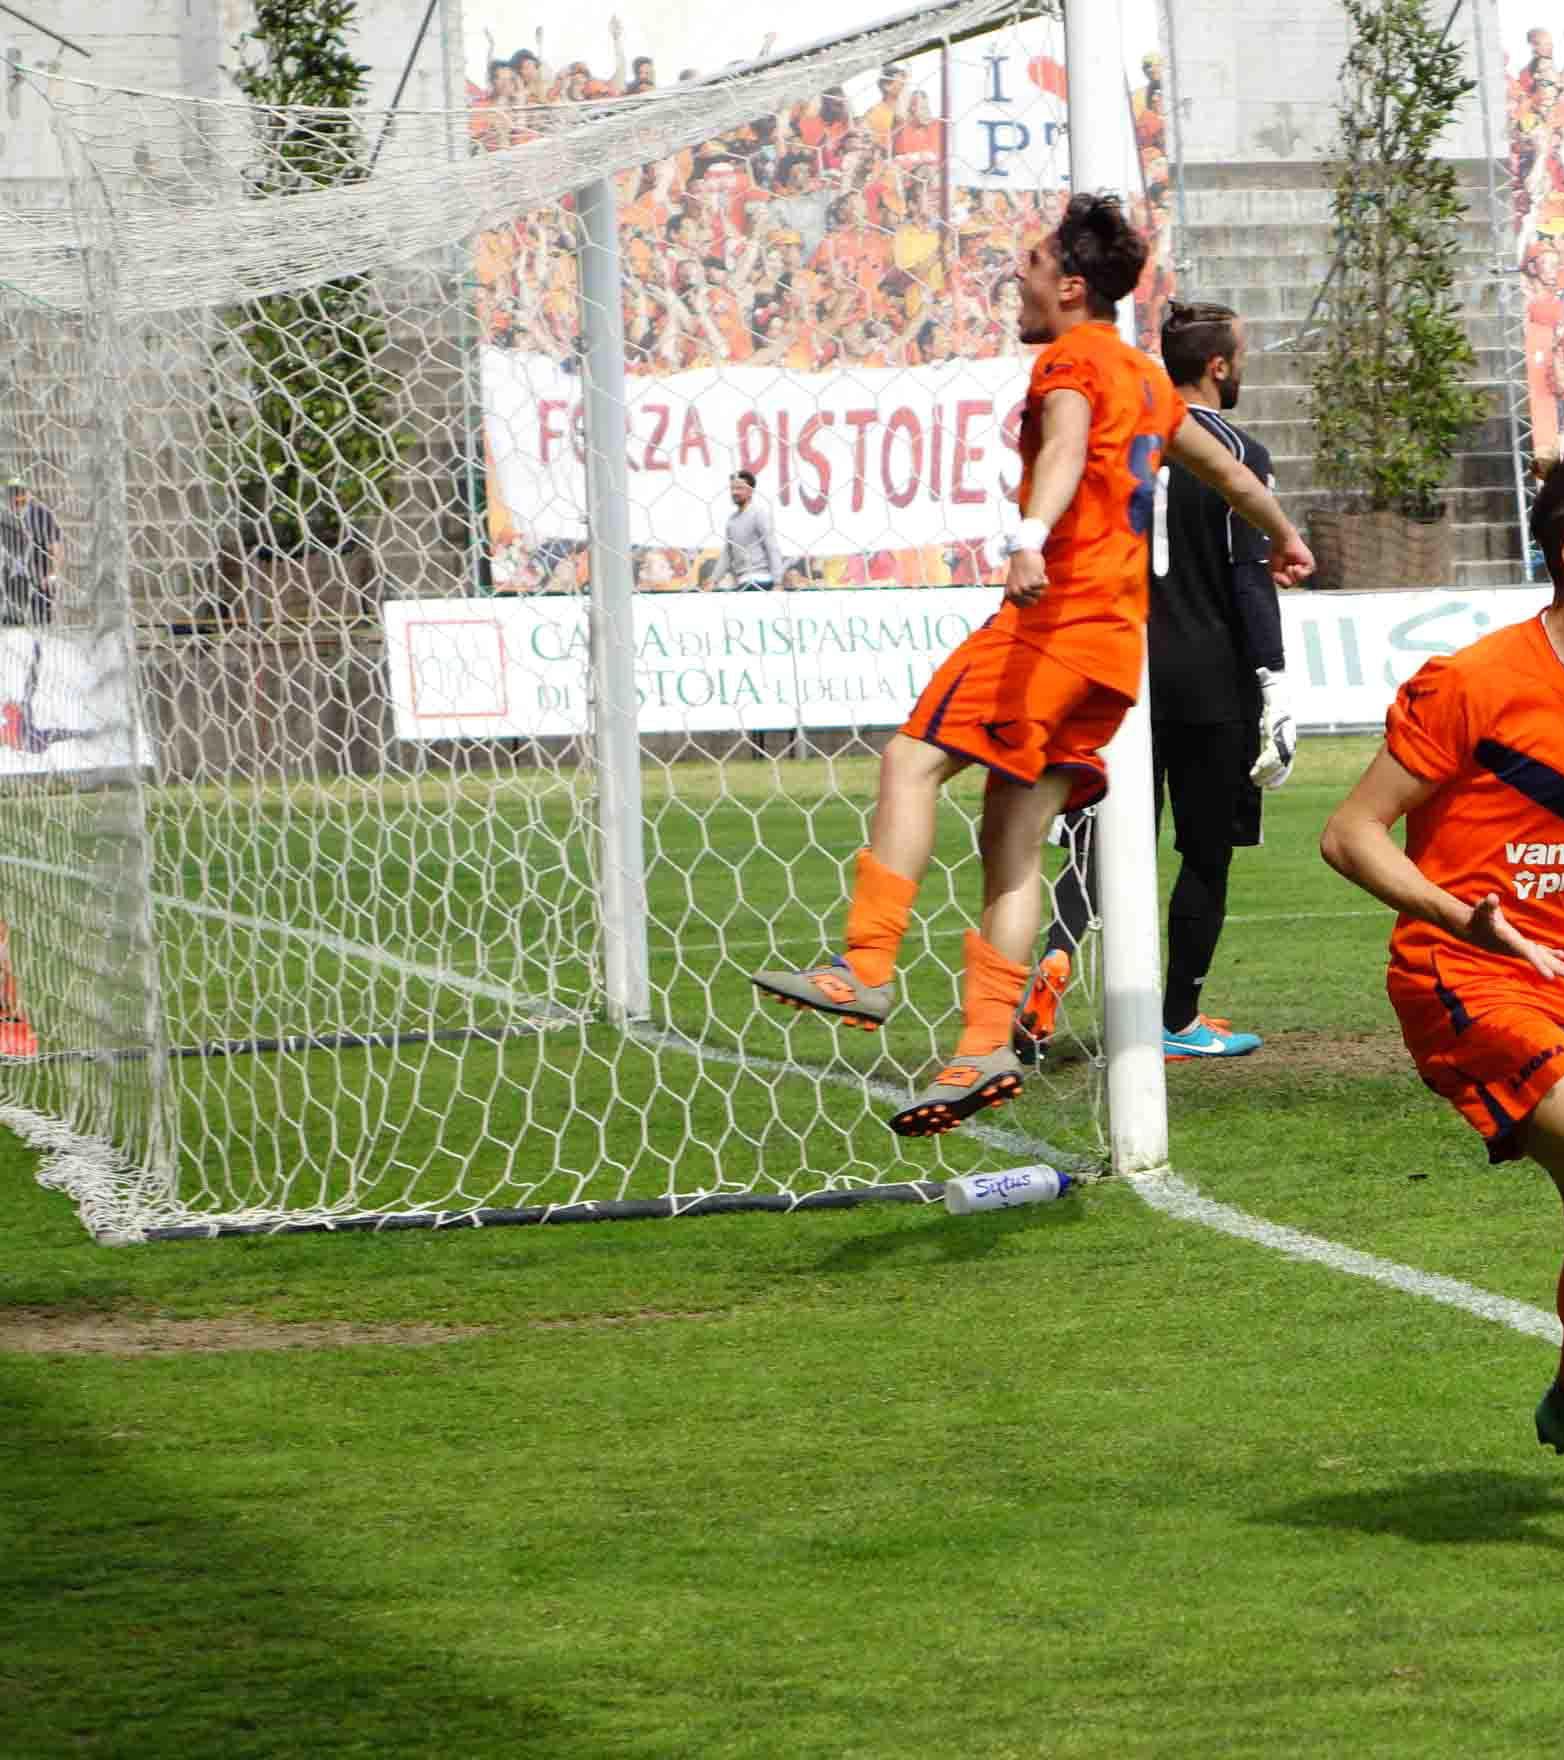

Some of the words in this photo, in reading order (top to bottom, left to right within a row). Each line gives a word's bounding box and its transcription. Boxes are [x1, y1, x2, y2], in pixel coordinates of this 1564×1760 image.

[538, 400, 712, 472] FZA
[531, 621, 669, 662] CAA
[725, 612, 971, 656] RISPARMIO
